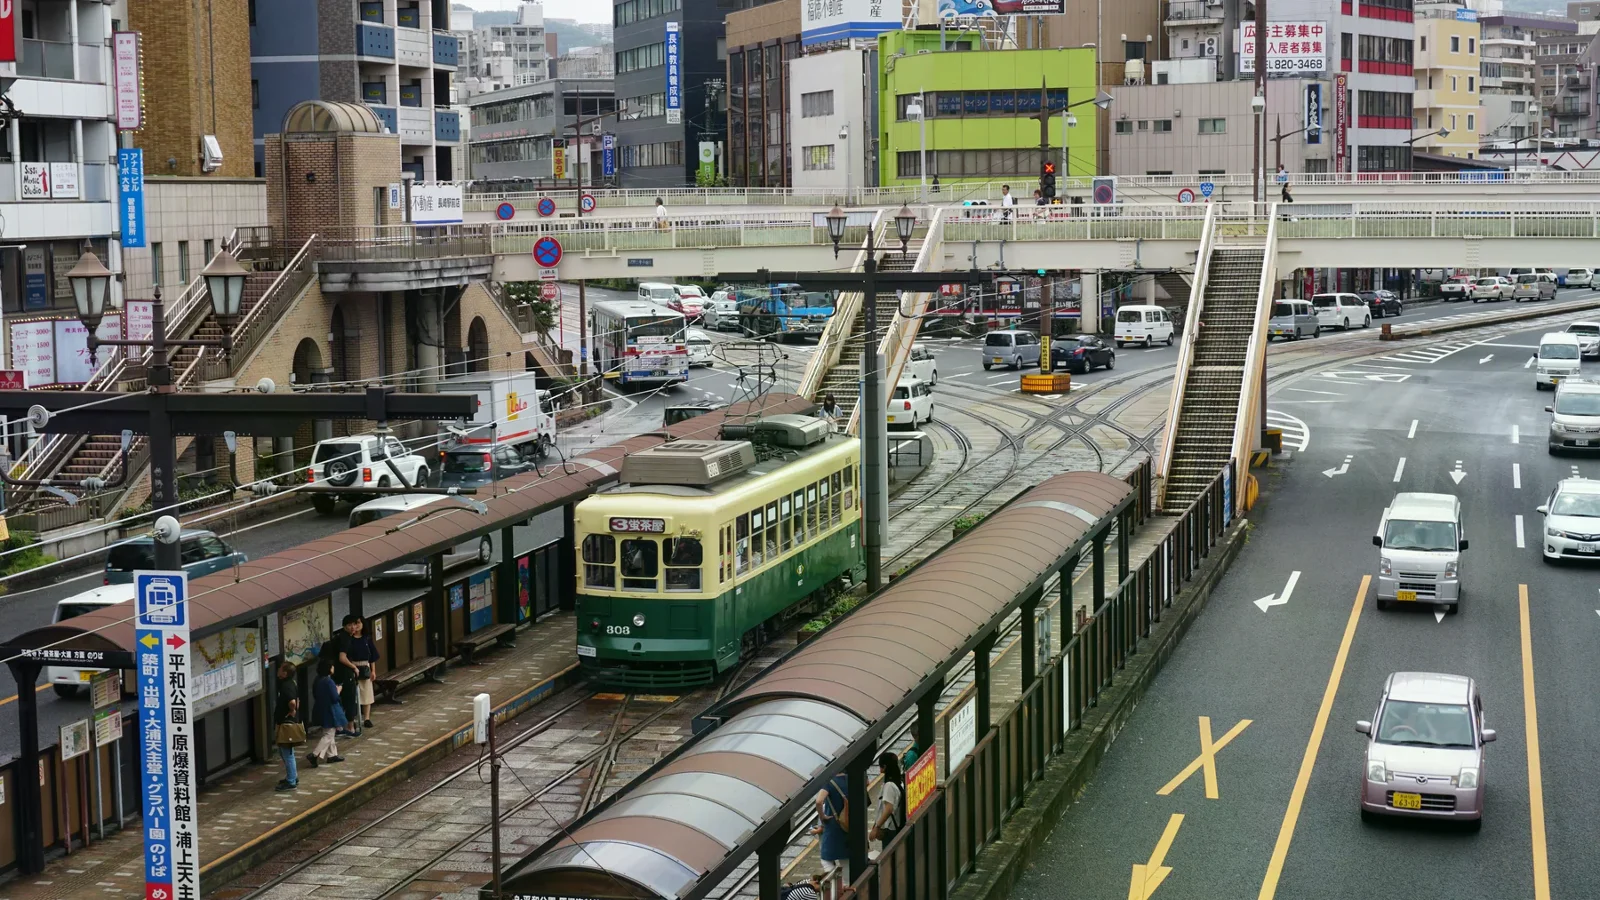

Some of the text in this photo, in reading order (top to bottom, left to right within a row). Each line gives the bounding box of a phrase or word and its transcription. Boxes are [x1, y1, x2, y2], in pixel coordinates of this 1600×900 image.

[1243, 41, 1322, 54] 店入居者募集
[668, 33, 679, 107] 長崎教員養成塾
[1274, 59, 1323, 70] 820-3468
[130, 152, 140, 192] アナミビル
[23, 184, 42, 195] Studio
[1181, 193, 1192, 203] 50
[127, 197, 137, 236] 管理事務所
[0, 381, 22, 389] アイフル
[611, 518, 629, 531] 3
[606, 625, 631, 635] 303
